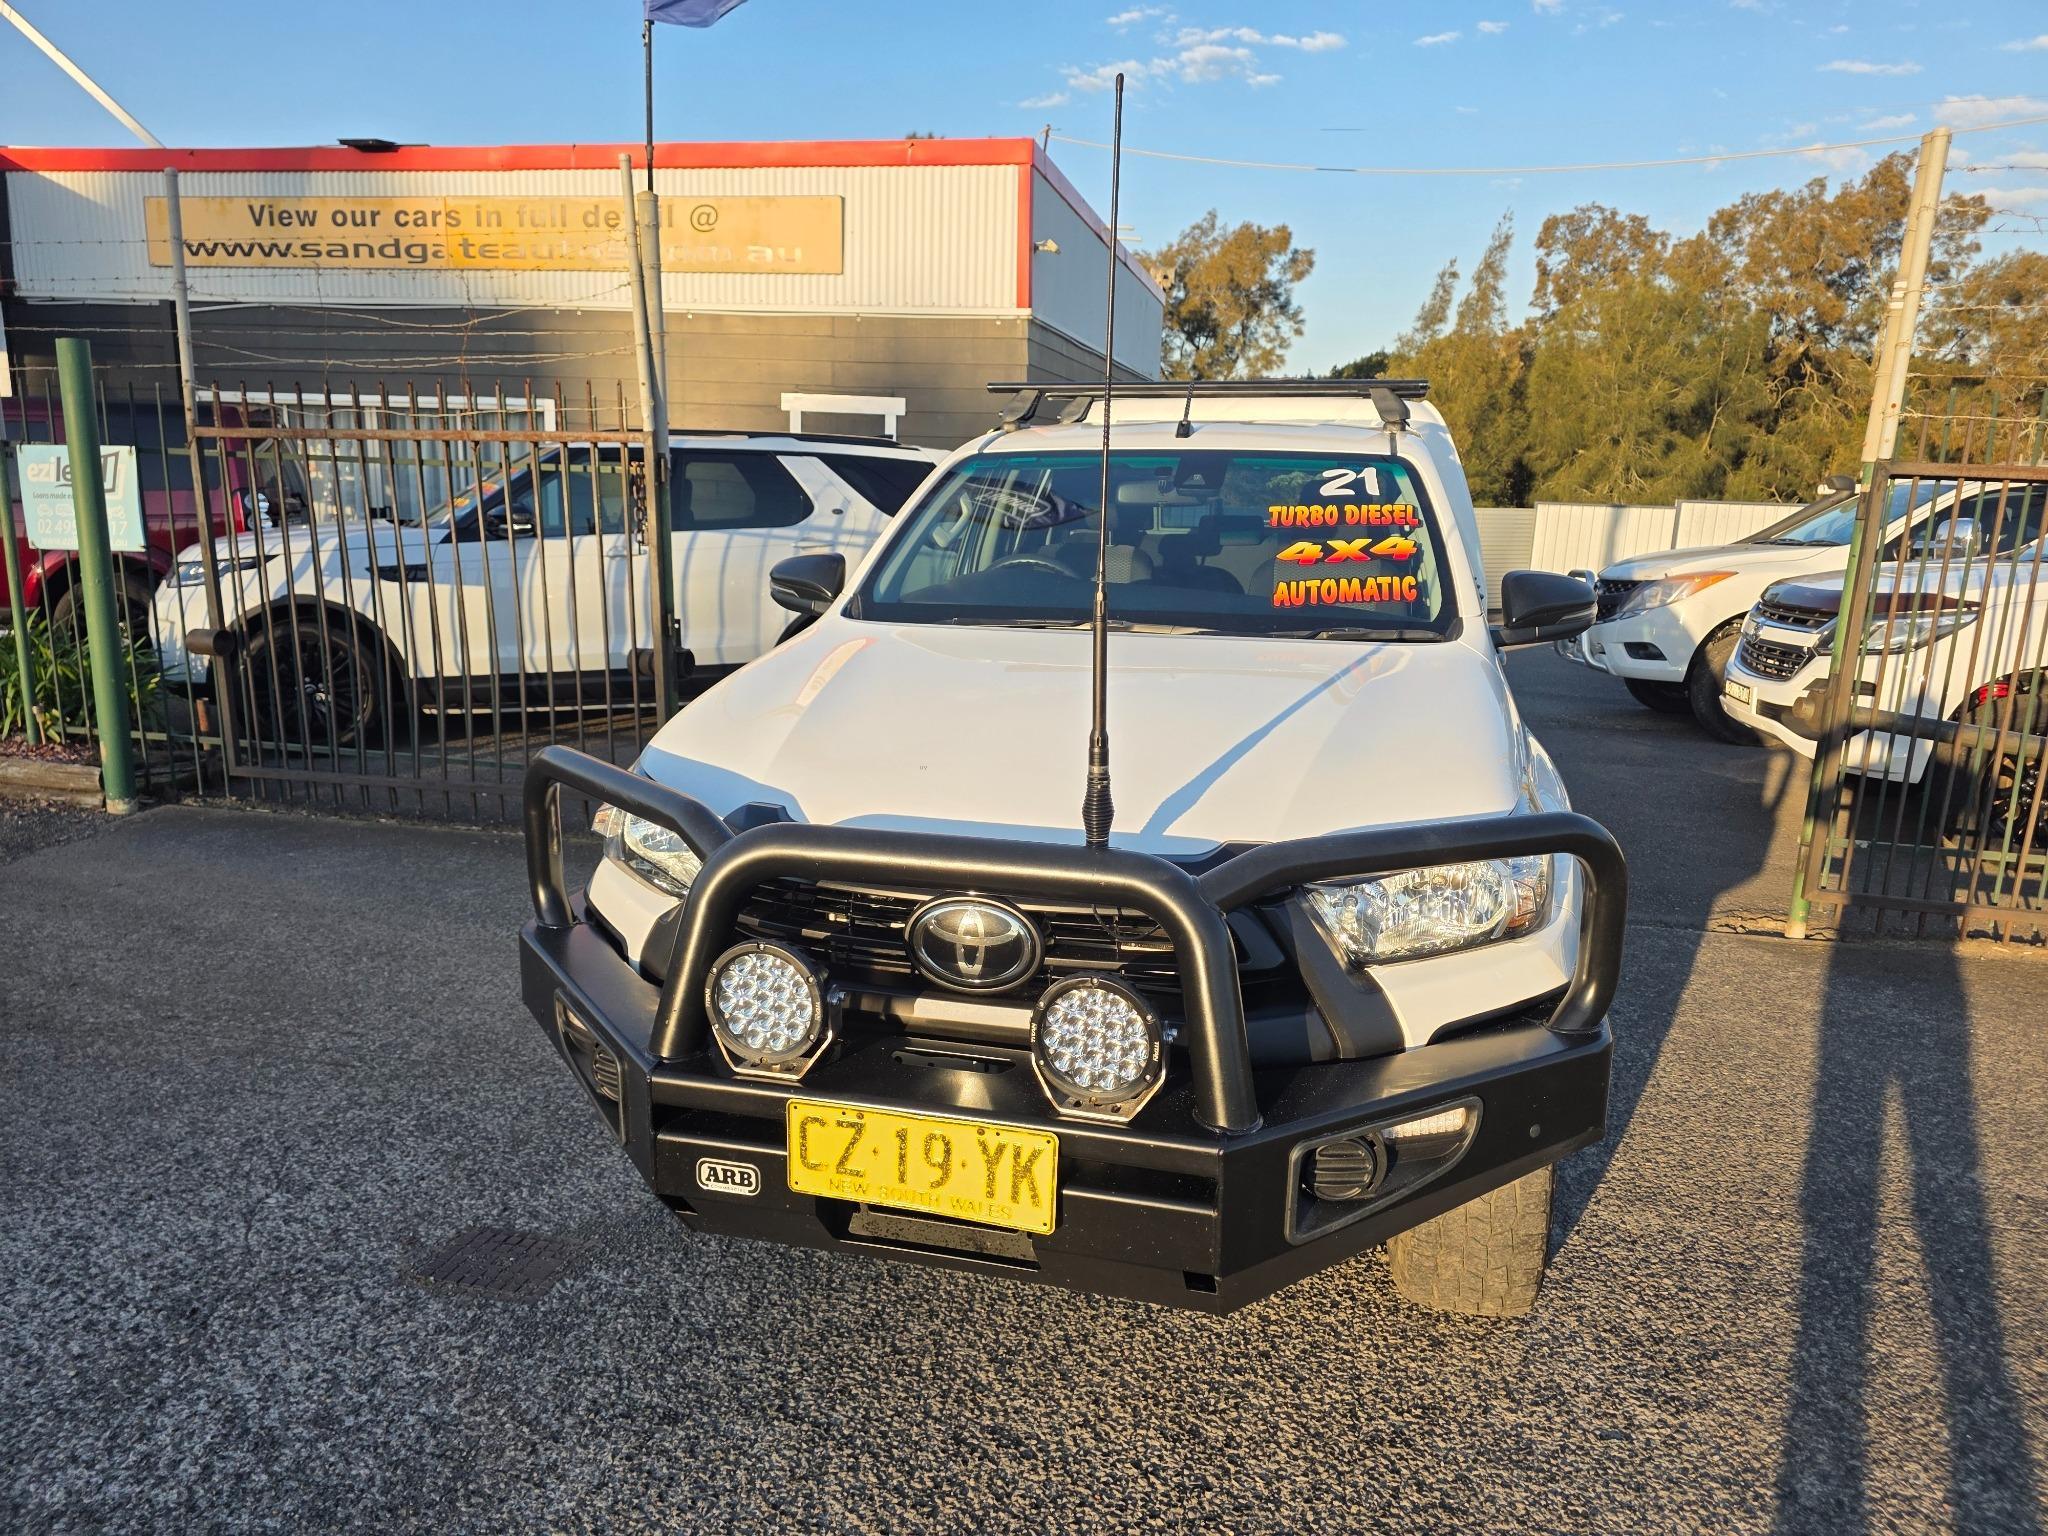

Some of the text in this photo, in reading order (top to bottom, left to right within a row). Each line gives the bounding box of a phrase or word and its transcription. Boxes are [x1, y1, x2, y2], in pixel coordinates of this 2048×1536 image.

[248, 203, 719, 233] View our cars in full deil @
[1319, 466, 1380, 496] 21
[1268, 504, 1421, 528] TURBO DIESEL
[1273, 575, 1418, 608] AUTOMATIC
[705, 1166, 754, 1188] ARB
[829, 1176, 1014, 1221] NEW SOUTH WALES
